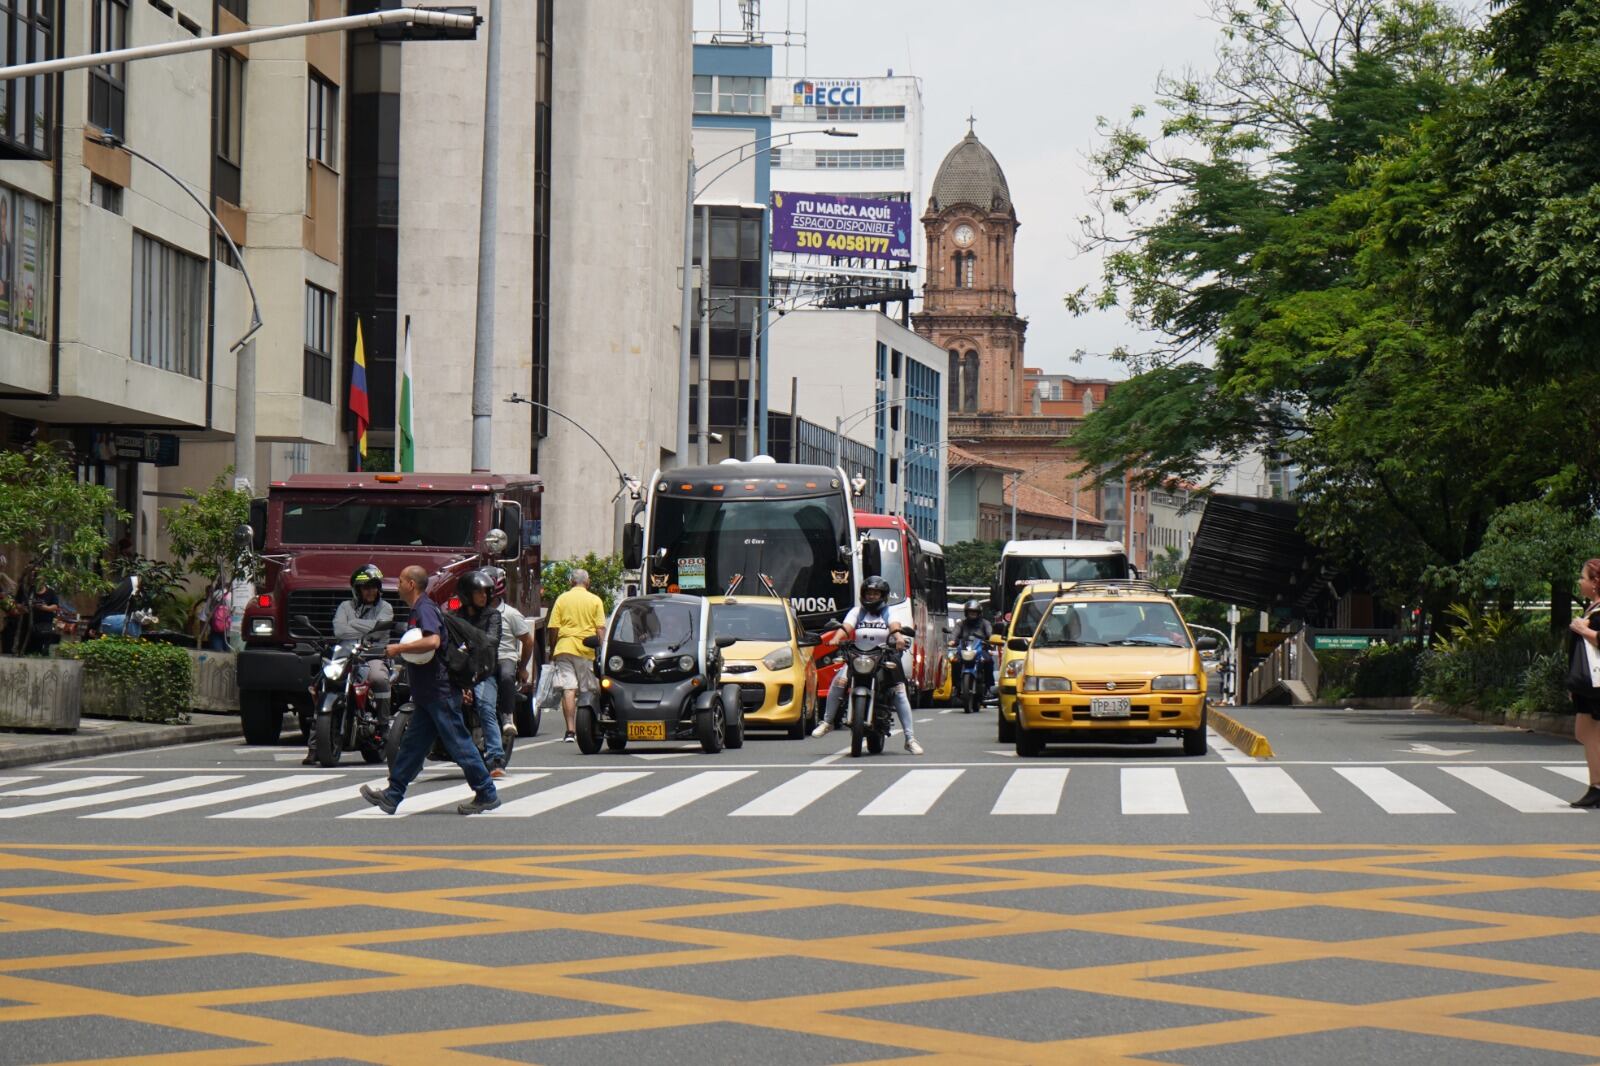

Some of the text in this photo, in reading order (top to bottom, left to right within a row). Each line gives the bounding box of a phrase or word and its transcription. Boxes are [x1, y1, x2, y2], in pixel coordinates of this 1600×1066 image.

[815, 87, 861, 105] ECCI
[796, 200, 891, 219] ¡TU MARCA AQUÍ!
[792, 216, 894, 234] ESPACIO DISPONIBLE
[796, 231, 823, 248] 310
[826, 233, 889, 253] 4058177
[877, 538, 898, 553] VO
[789, 597, 837, 612] MOSA
